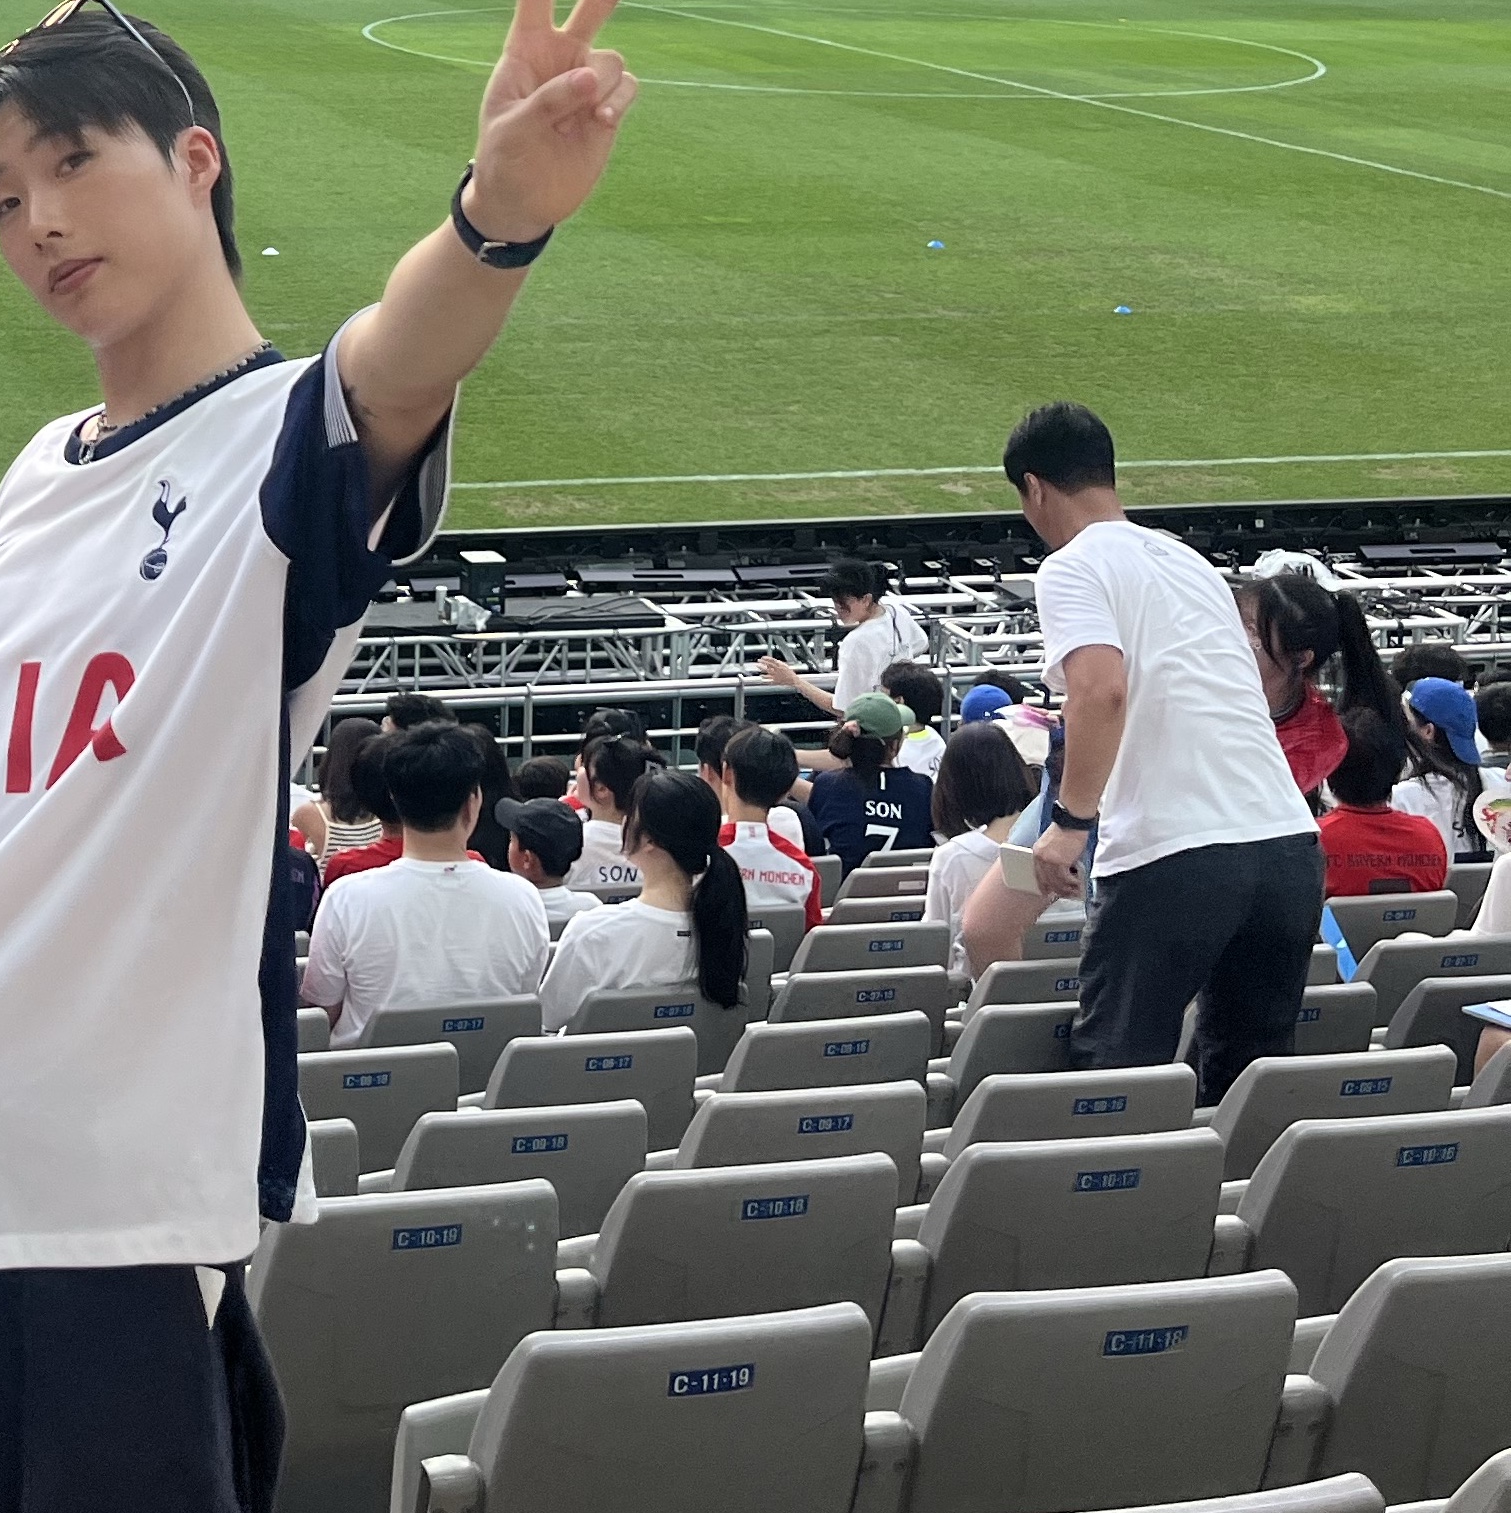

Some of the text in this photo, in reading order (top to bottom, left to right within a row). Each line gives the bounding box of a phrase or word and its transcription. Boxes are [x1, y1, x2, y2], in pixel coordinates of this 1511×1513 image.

[865, 800, 902, 820] SON
[865, 824, 900, 852] 7
[598, 866, 638, 883] SON
